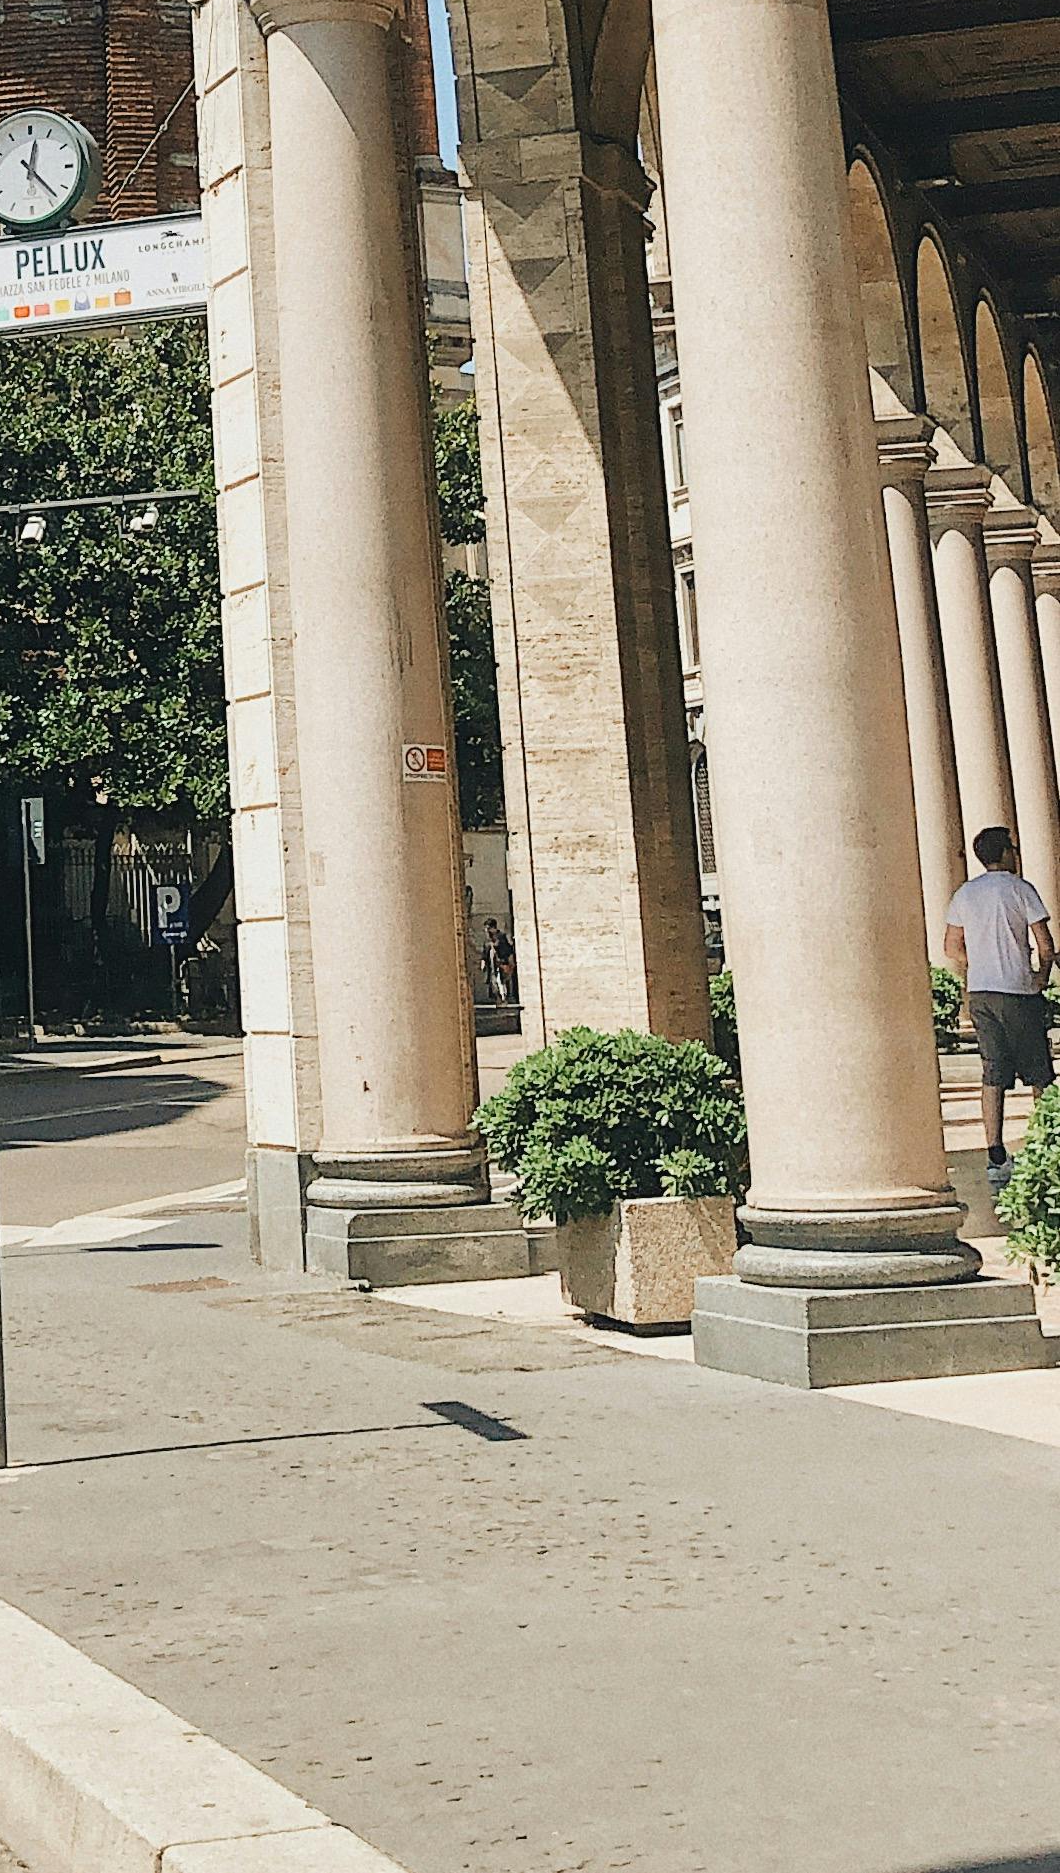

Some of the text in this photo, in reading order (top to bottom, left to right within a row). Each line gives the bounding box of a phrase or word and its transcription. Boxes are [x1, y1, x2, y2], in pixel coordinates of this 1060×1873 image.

[15, 239, 106, 280] PELLUX
[27, 280, 46, 294] SAN
[49, 277, 81, 291] FEDELE
[85, 274, 91, 287] 2
[94, 269, 130, 285] MILANO
[146, 287, 171, 297] ANNA
[156, 886, 181, 929] P
